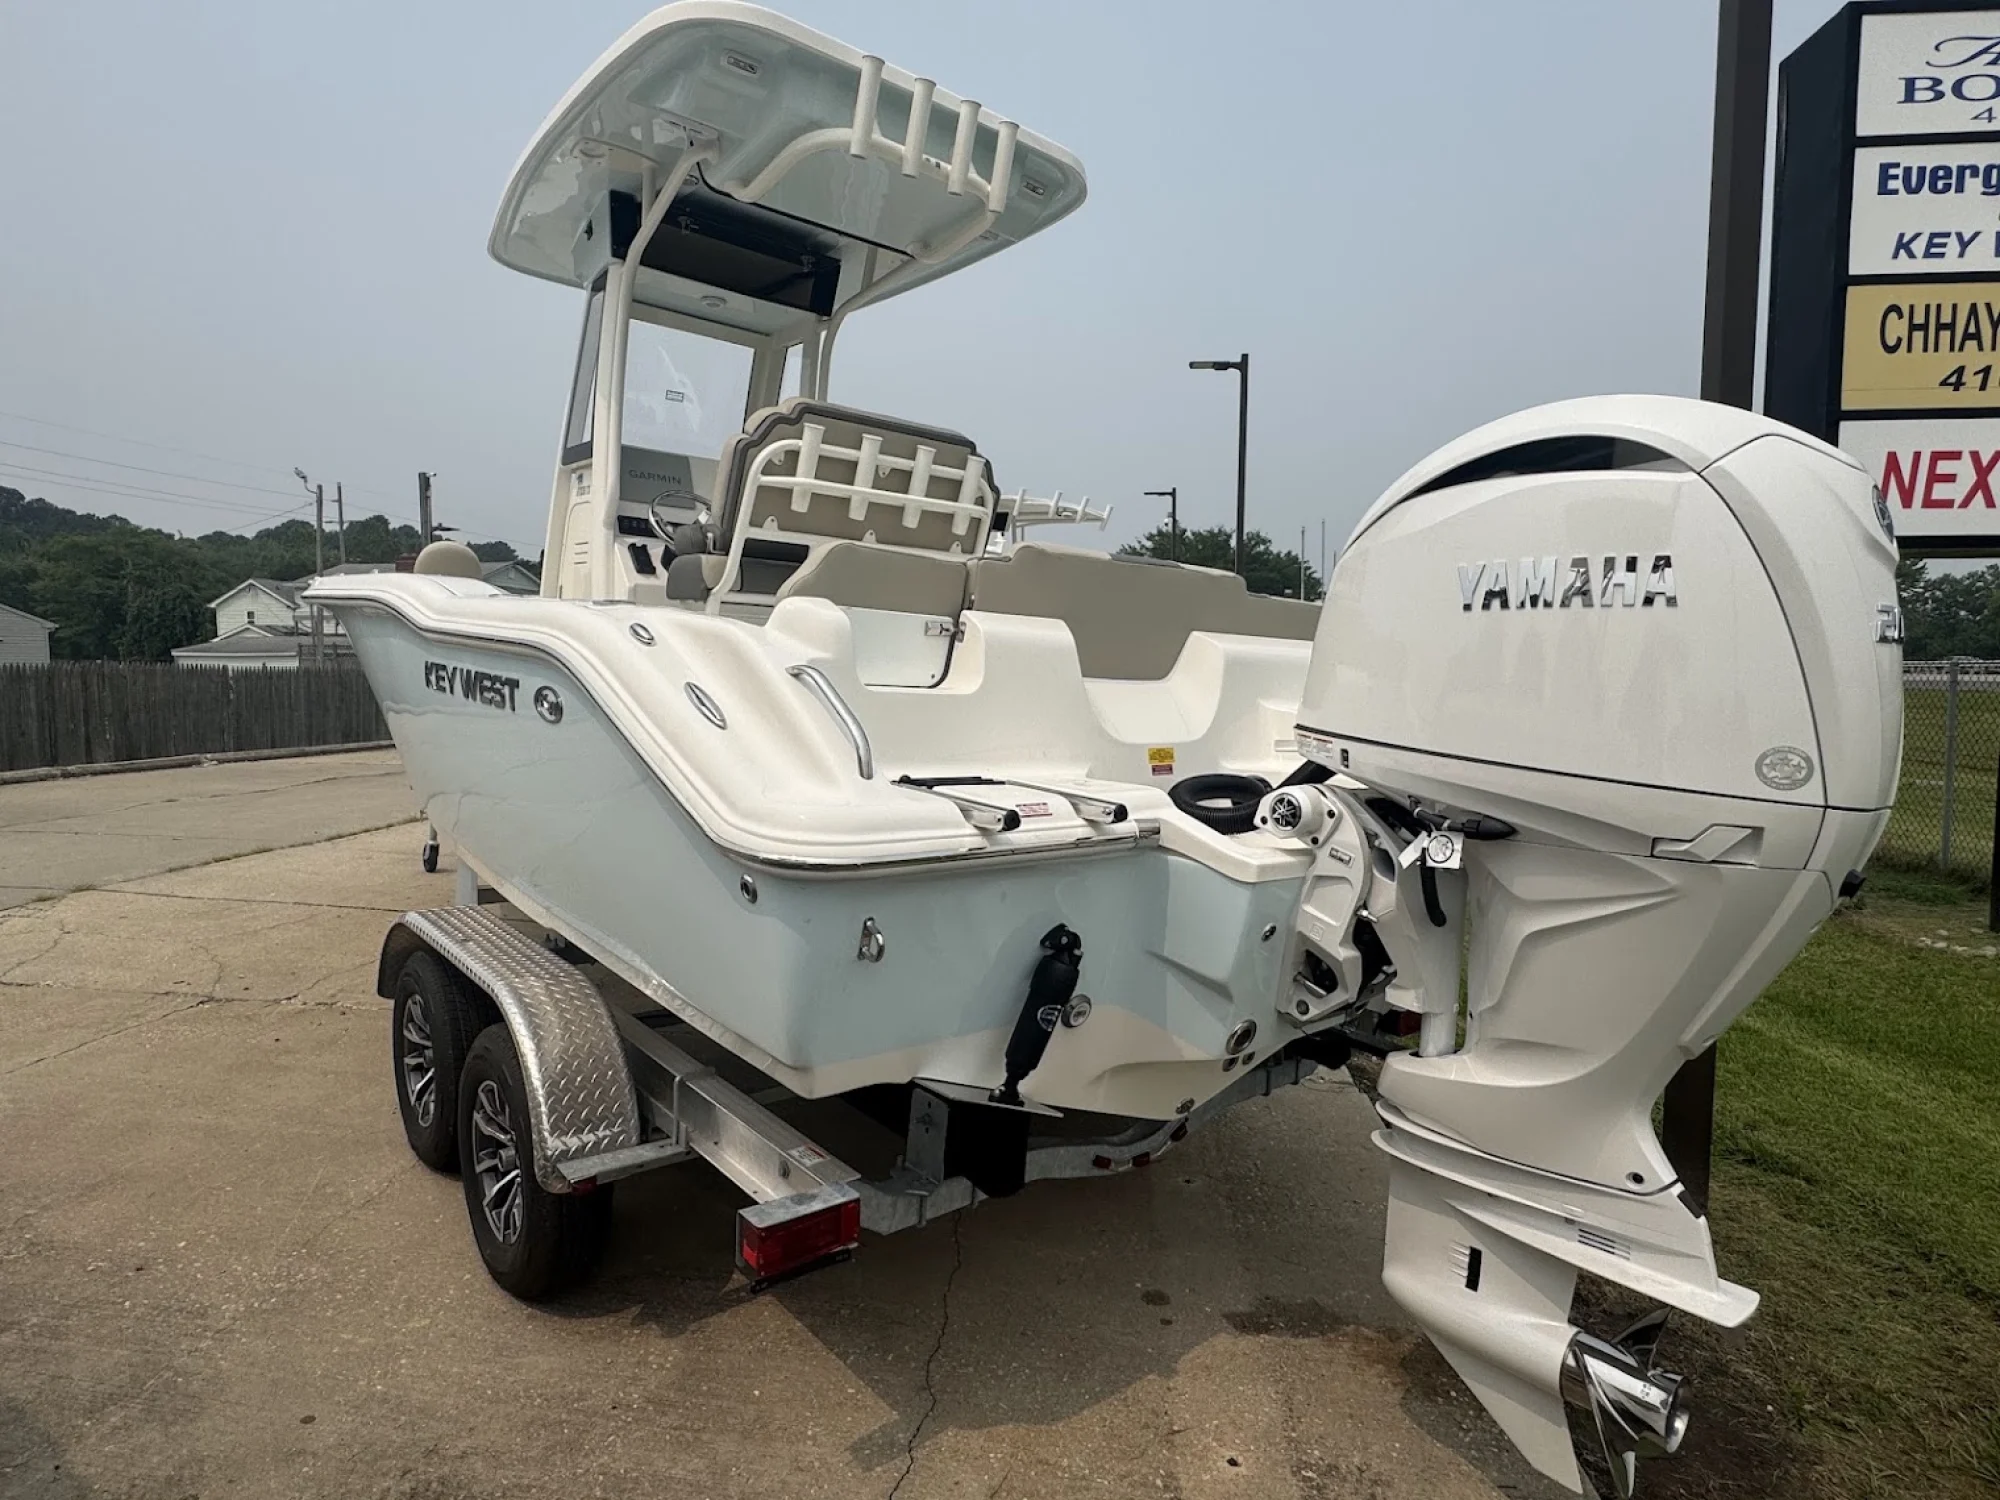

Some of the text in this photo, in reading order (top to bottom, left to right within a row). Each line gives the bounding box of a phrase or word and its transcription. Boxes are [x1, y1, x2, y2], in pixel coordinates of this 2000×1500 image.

[1897, 74, 2000, 104] BO
[1970, 106, 1997, 124] 4
[1877, 162, 2000, 196] Everg
[1891, 231, 1983, 260] KEY
[1879, 302, 2000, 354] CHHAY
[628, 469, 682, 486] GARMIN
[1880, 450, 2000, 509] NEX
[1456, 552, 1679, 612] YAMAHA
[424, 659, 520, 713] KEY WEST
